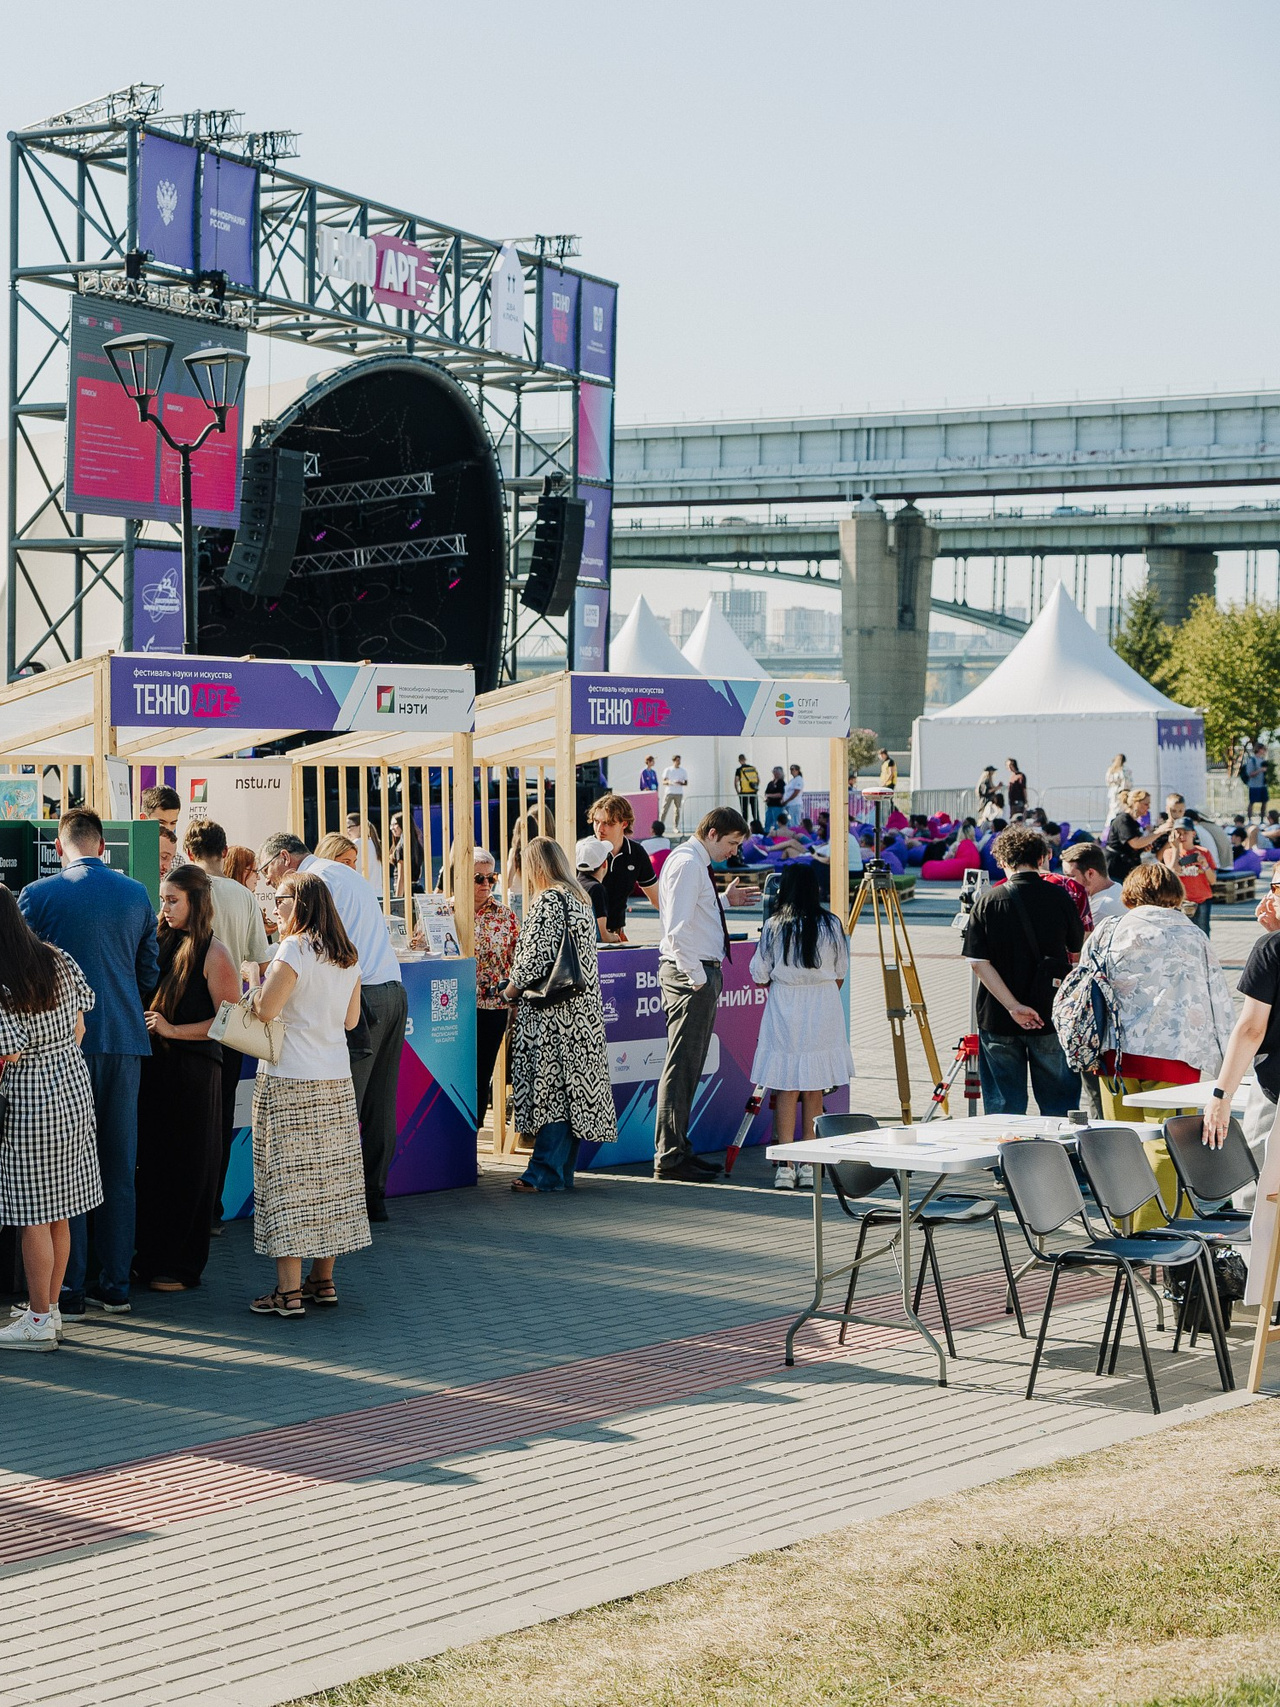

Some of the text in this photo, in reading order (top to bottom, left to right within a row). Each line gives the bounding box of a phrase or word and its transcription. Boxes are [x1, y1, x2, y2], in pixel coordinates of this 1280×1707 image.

[380, 249, 418, 296] АРТ
[133, 668, 171, 678] фестиваль
[172, 670, 193, 680] науки
[200, 671, 233, 680] искусства
[588, 684, 617, 693] фестиваль
[618, 686, 634, 695] науки
[133, 683, 227, 715] ТЕХНО АРТ
[399, 703, 428, 714] НЭТИ
[588, 698, 659, 725] ТЕХНО АРТ
[235, 777, 281, 789] nstu.ru
